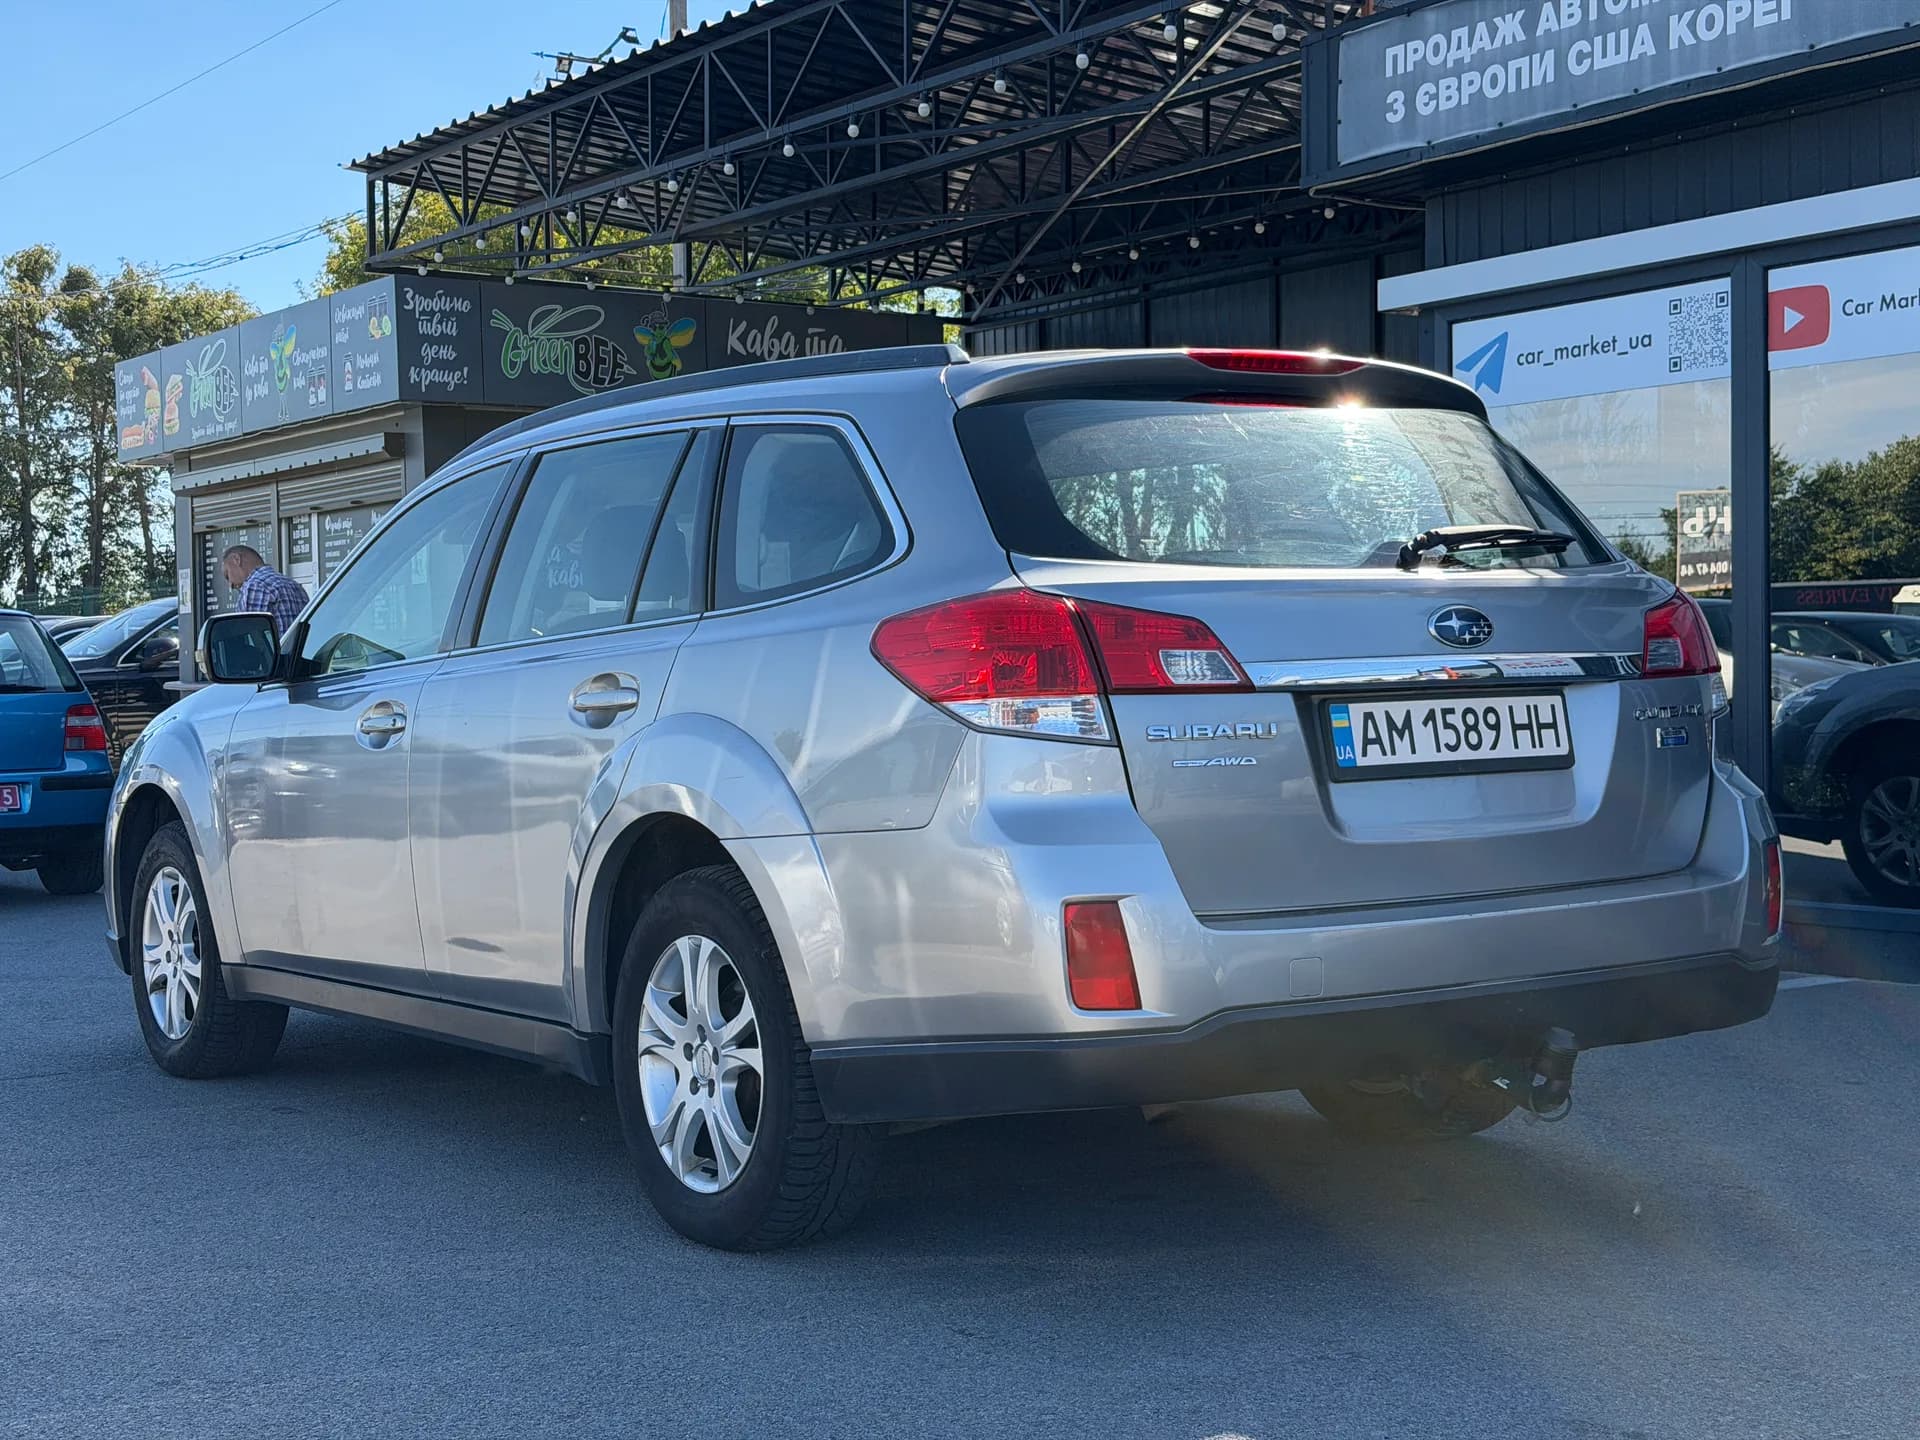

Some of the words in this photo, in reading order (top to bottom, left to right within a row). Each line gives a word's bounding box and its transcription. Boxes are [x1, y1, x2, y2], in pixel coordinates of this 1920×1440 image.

[1385, 10, 1526, 77] ПРОДАЖ
[1385, 90, 1405, 123] З
[1415, 49, 1554, 116] ЄВРОПИ
[1567, 23, 1656, 76] США
[403, 287, 472, 318] Зробимо
[1842, 299, 1874, 316] Car
[1880, 288, 1920, 312] Mar
[418, 314, 458, 337] твій
[727, 315, 799, 361] Кава
[421, 342, 457, 366] день
[1516, 334, 1652, 366] car_market_ua
[409, 366, 469, 392] краще!
[1146, 722, 1278, 742] SUBARU
[1336, 745, 1354, 760] UA
[1361, 709, 1417, 757] AM
[1421, 706, 1501, 753] 1589
[1508, 703, 1561, 750] HH
[3, 788, 13, 806] 5
